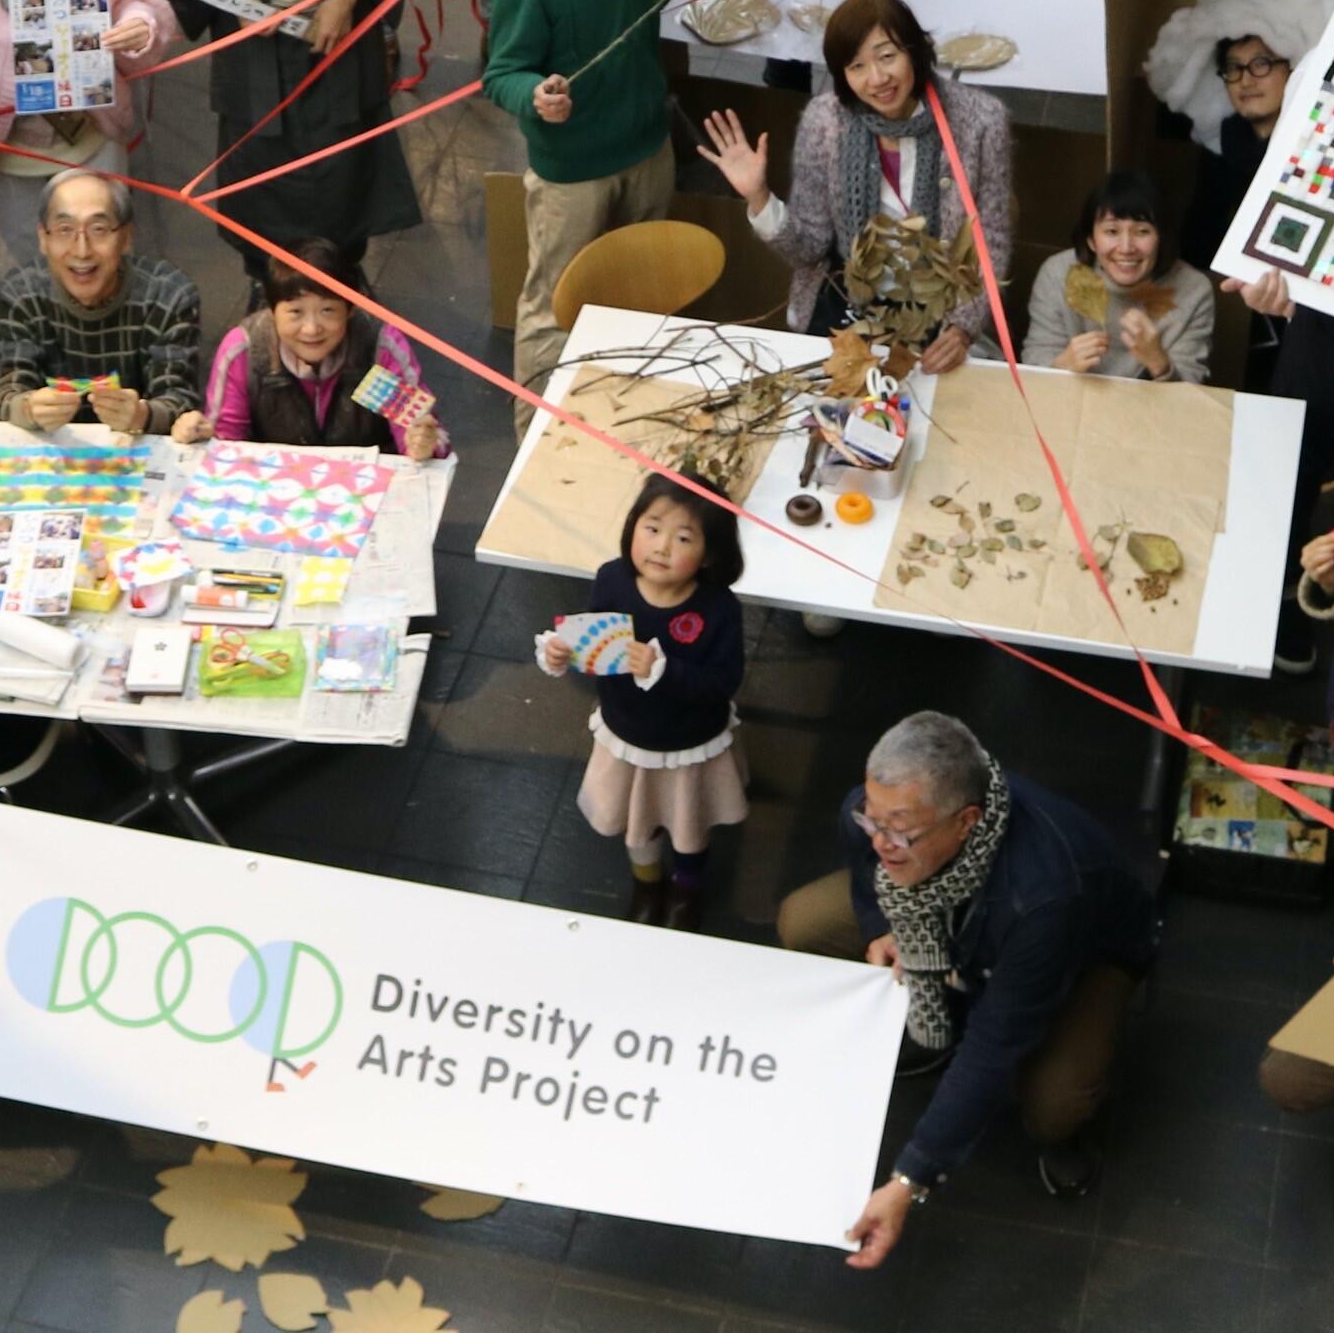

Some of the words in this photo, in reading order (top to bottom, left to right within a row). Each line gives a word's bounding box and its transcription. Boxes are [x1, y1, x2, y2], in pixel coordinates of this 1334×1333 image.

[370, 973, 592, 1060] Diversity
[613, 1028, 675, 1065] on
[698, 1034, 778, 1082] the
[357, 1034, 458, 1087] Arts
[479, 1056, 660, 1123] Project
